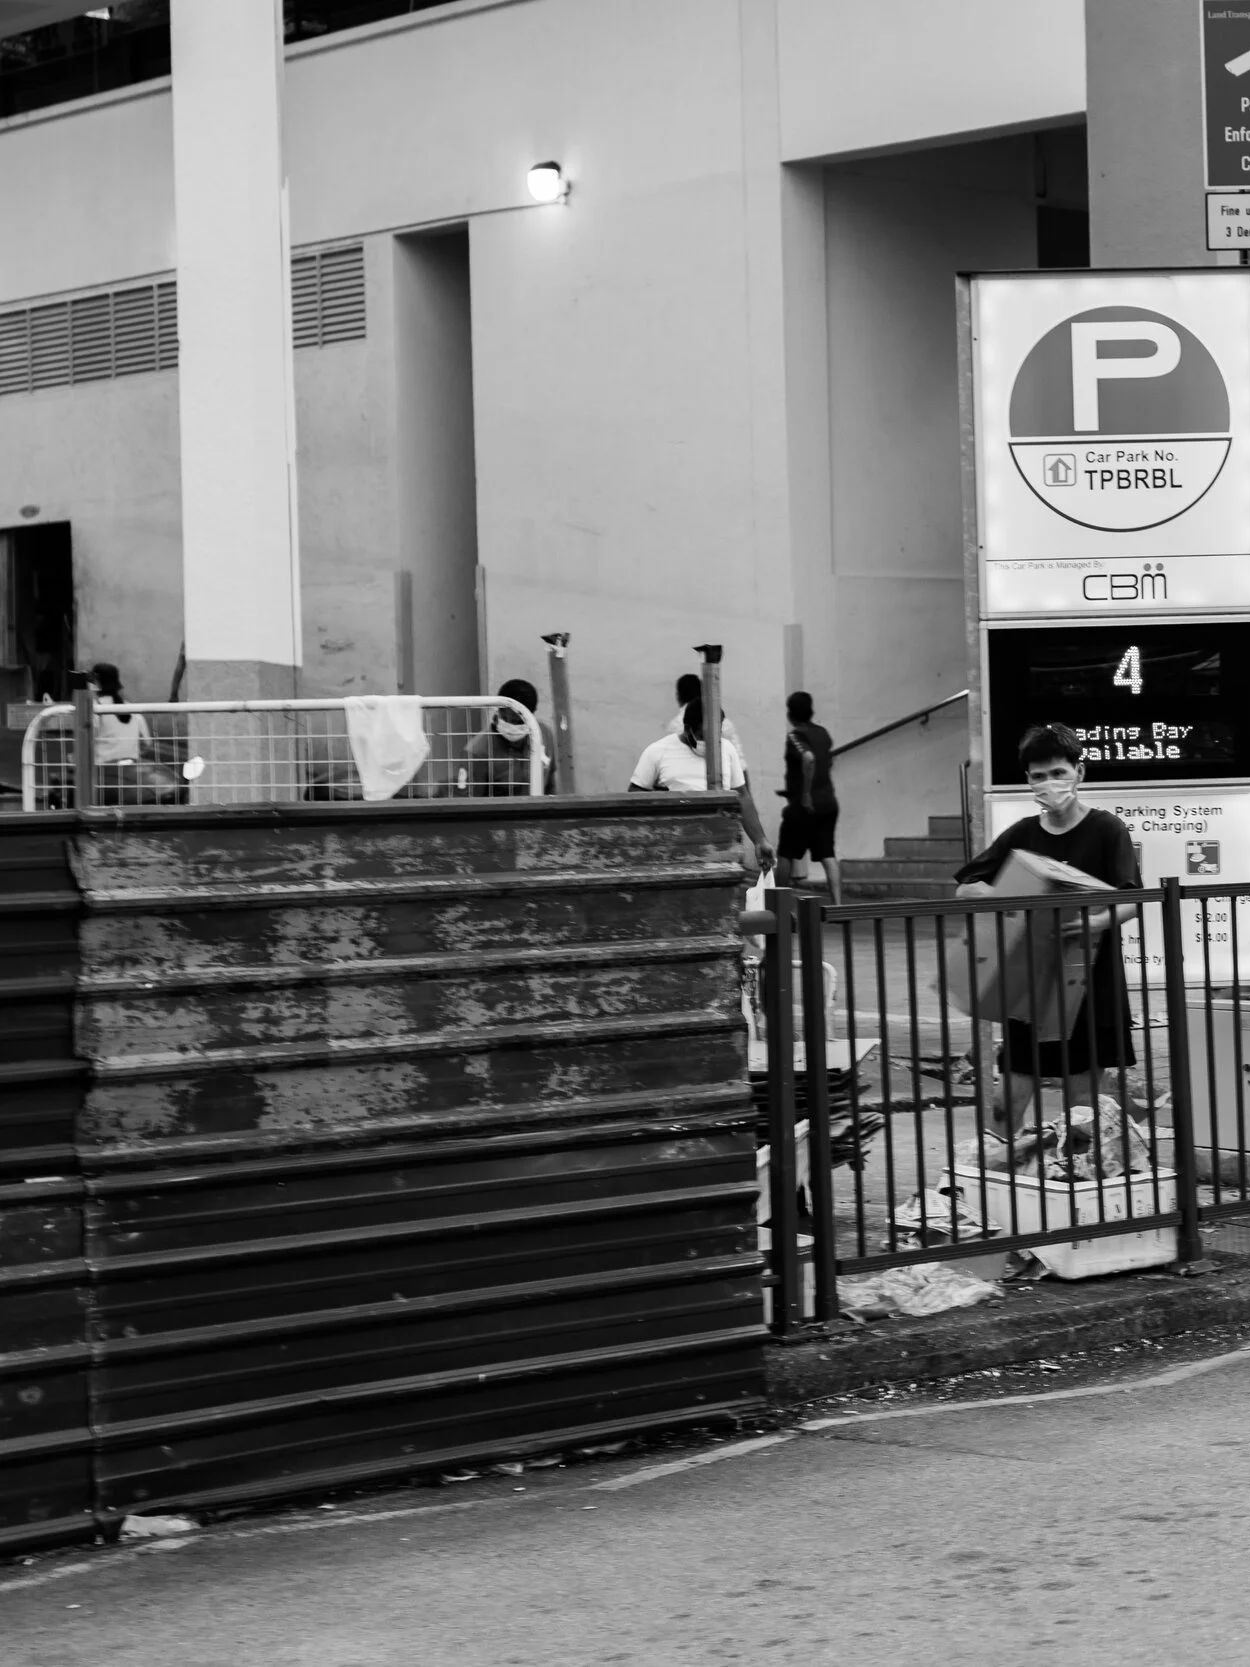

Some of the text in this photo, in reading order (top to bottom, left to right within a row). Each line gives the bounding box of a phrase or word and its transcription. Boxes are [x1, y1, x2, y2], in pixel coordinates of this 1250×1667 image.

[1221, 205, 1240, 216] Fine
[1226, 227, 1232, 237] 3
[1071, 321, 1181, 431] P
[1085, 449, 1179, 463] Car Park No.
[1084, 468, 1183, 490] TPBRBL
[1113, 646, 1143, 694] 4
[1152, 722, 1193, 739] Bay
[1115, 804, 1223, 819] Parking System
[1142, 820, 1208, 833] Charging)
